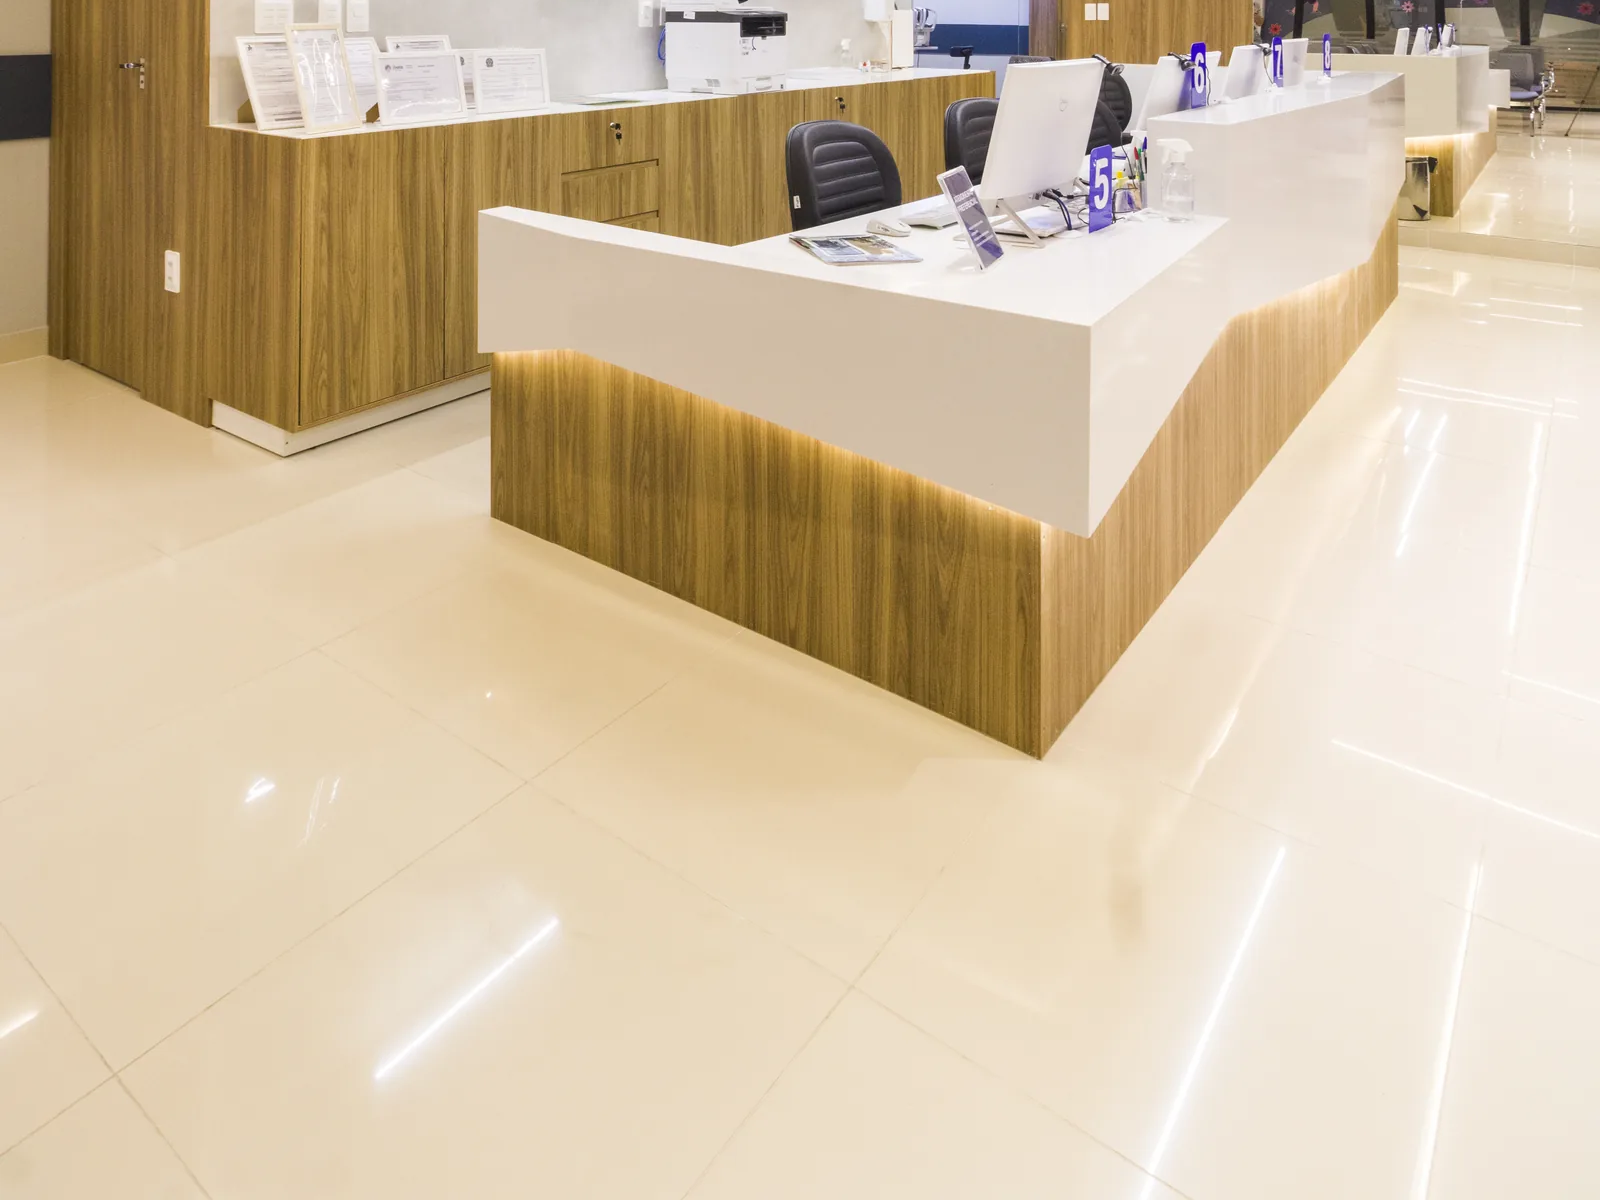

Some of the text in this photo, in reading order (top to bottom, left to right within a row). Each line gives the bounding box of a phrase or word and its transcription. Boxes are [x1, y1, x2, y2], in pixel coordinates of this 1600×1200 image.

[1194, 52, 1205, 93] 6
[1274, 44, 1283, 80] 7
[1324, 40, 1331, 69] 8
[1093, 157, 1109, 210] 5
